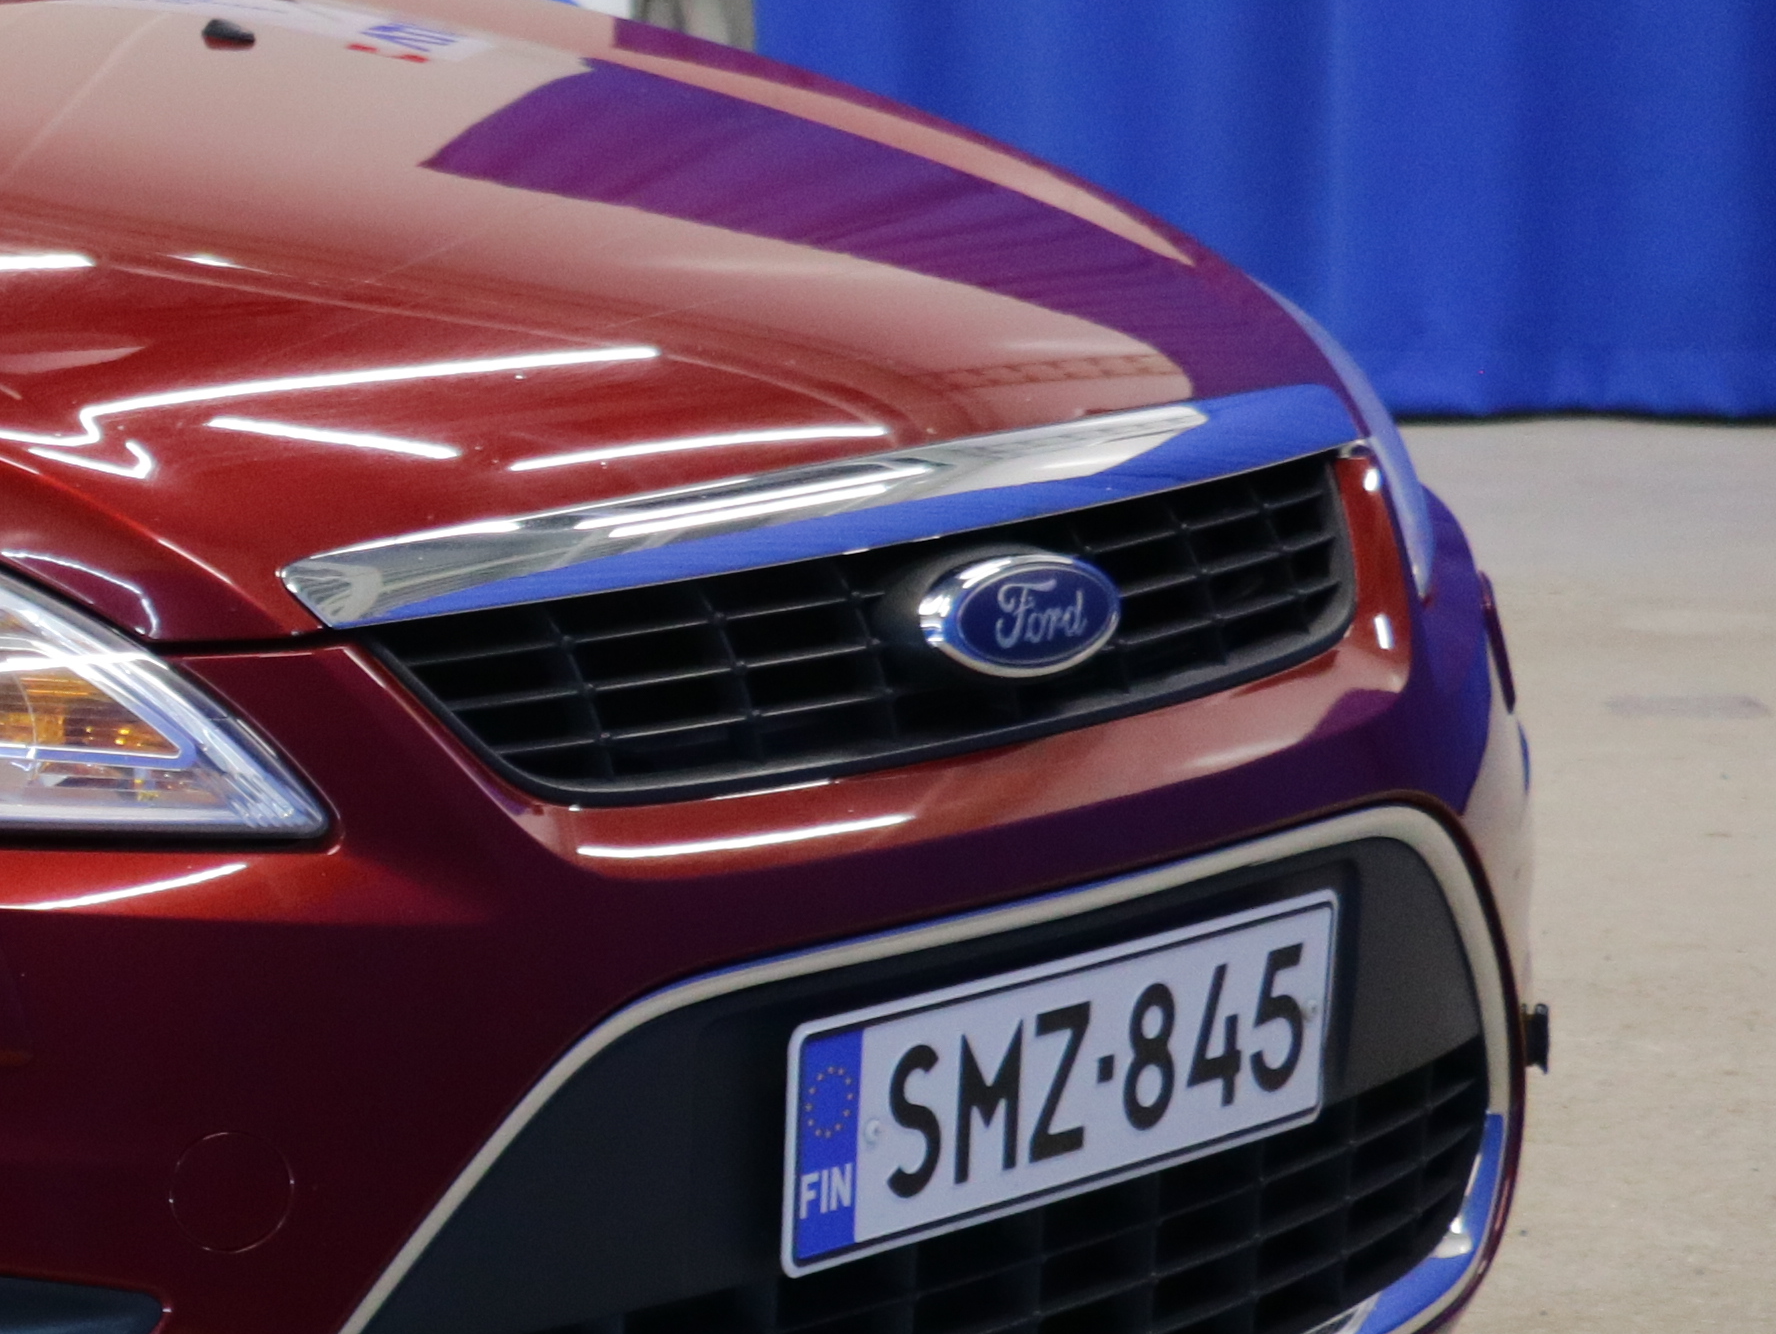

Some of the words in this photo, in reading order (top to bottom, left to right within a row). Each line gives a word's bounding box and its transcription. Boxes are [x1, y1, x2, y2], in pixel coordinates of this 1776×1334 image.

[995, 578, 1089, 650] Ford
[887, 943, 1304, 1198] SMZ-845
[799, 1161, 851, 1219] FIN
